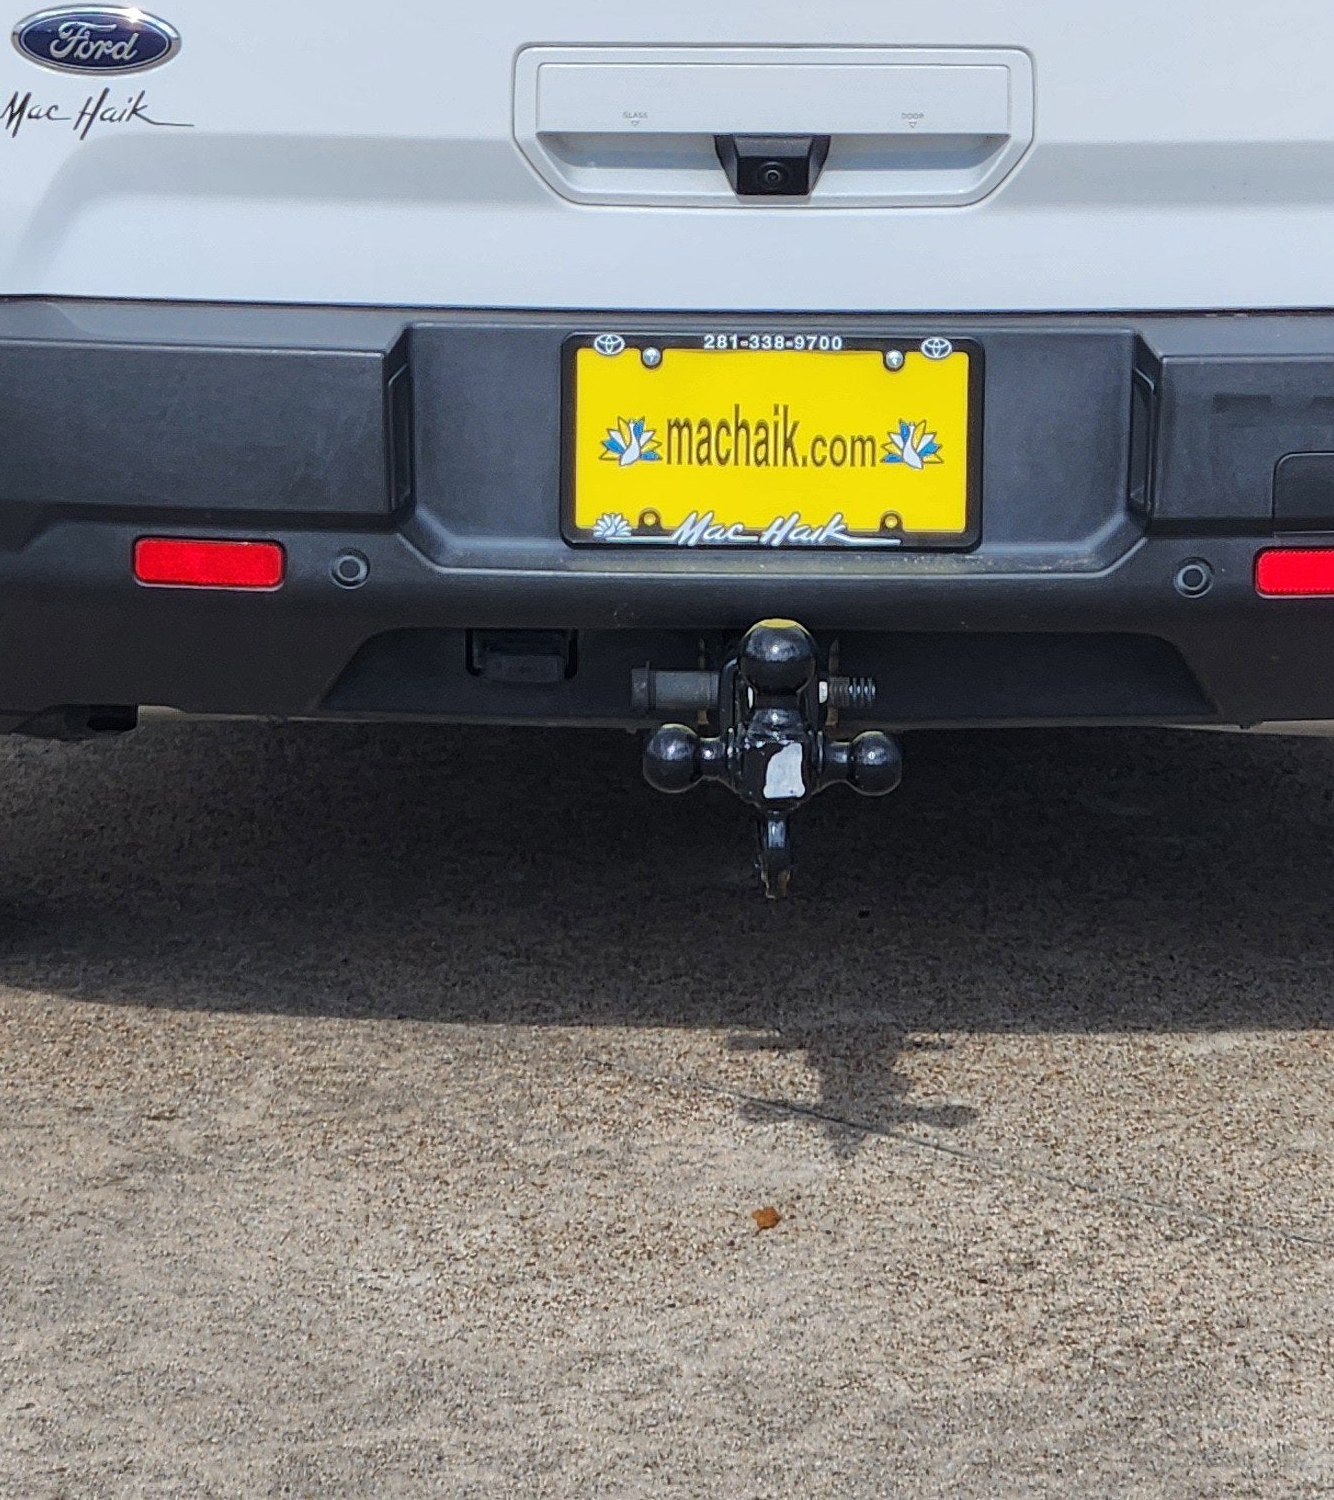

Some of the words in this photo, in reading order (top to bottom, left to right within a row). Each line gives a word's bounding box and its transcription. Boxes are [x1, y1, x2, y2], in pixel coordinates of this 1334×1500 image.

[50, 21, 139, 61] Ford
[73, 87, 194, 140] Haik
[703, 334, 843, 351] 281-338-9700
[666, 403, 877, 468] machaik.com
[669, 511, 758, 547] Mac
[759, 512, 902, 547] Haik
